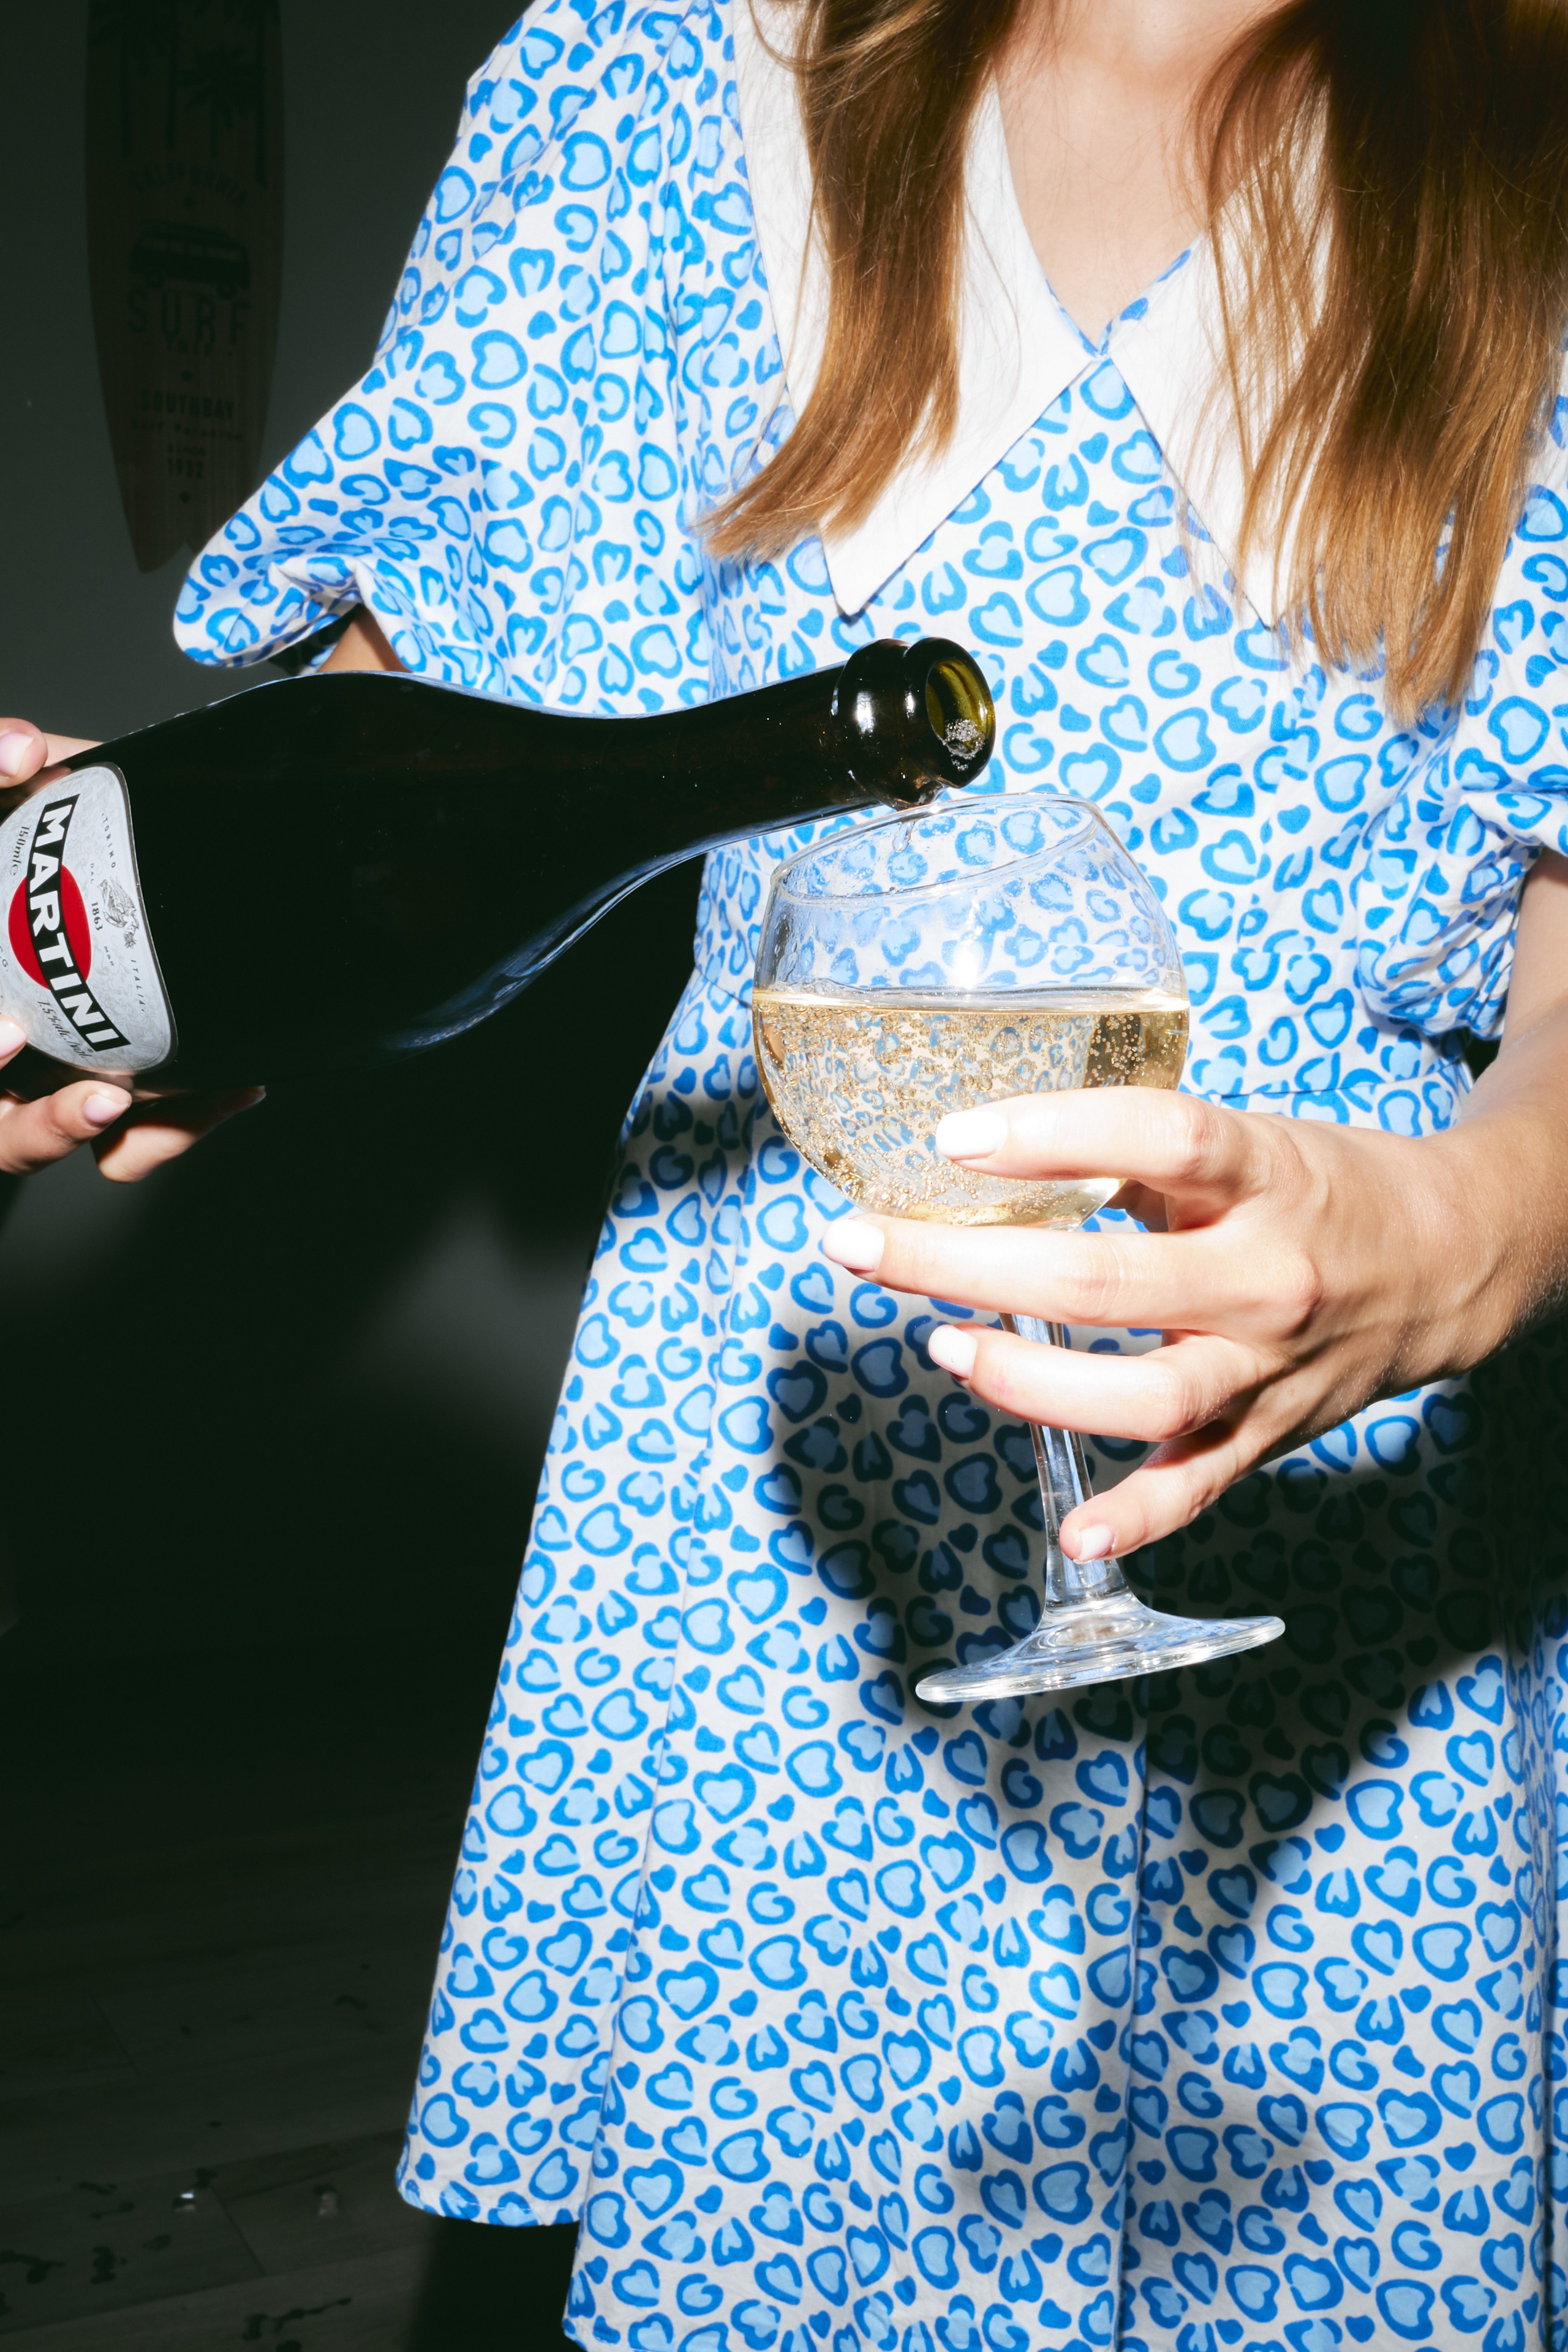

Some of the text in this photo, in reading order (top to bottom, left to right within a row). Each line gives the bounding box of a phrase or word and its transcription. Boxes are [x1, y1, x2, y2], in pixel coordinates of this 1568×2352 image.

[129, 162, 248, 209] CALIFORNIA
[127, 288, 251, 347] SURF
[140, 388, 235, 420] SOUTHBAY
[102, 816, 116, 869] TORINO
[29, 804, 119, 1043] MARTINI
[91, 902, 103, 931] 1863
